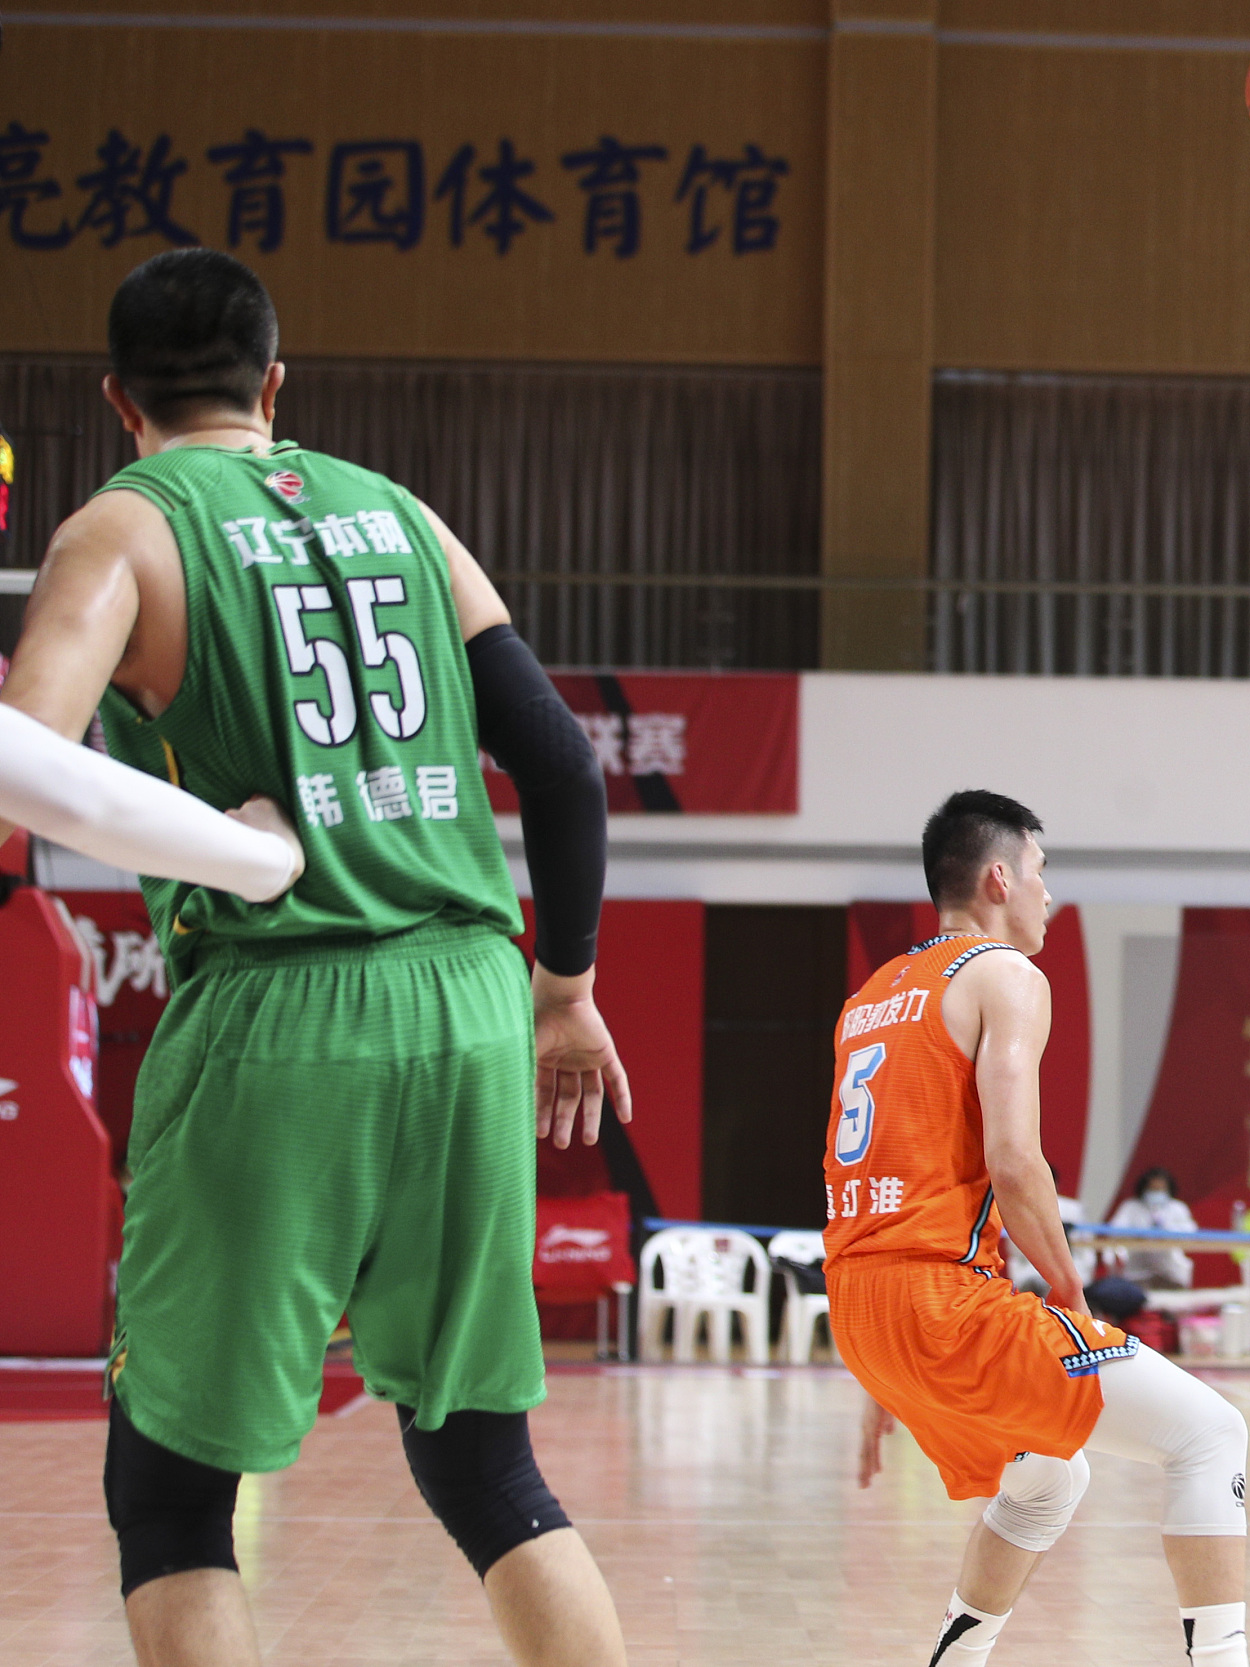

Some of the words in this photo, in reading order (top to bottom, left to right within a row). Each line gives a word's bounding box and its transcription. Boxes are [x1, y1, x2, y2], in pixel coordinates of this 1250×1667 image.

[222, 509, 413, 569] 辽宁本钢
[272, 576, 427, 749] 55
[296, 765, 460, 829] 韩德君
[835, 1042, 887, 1167] 5
